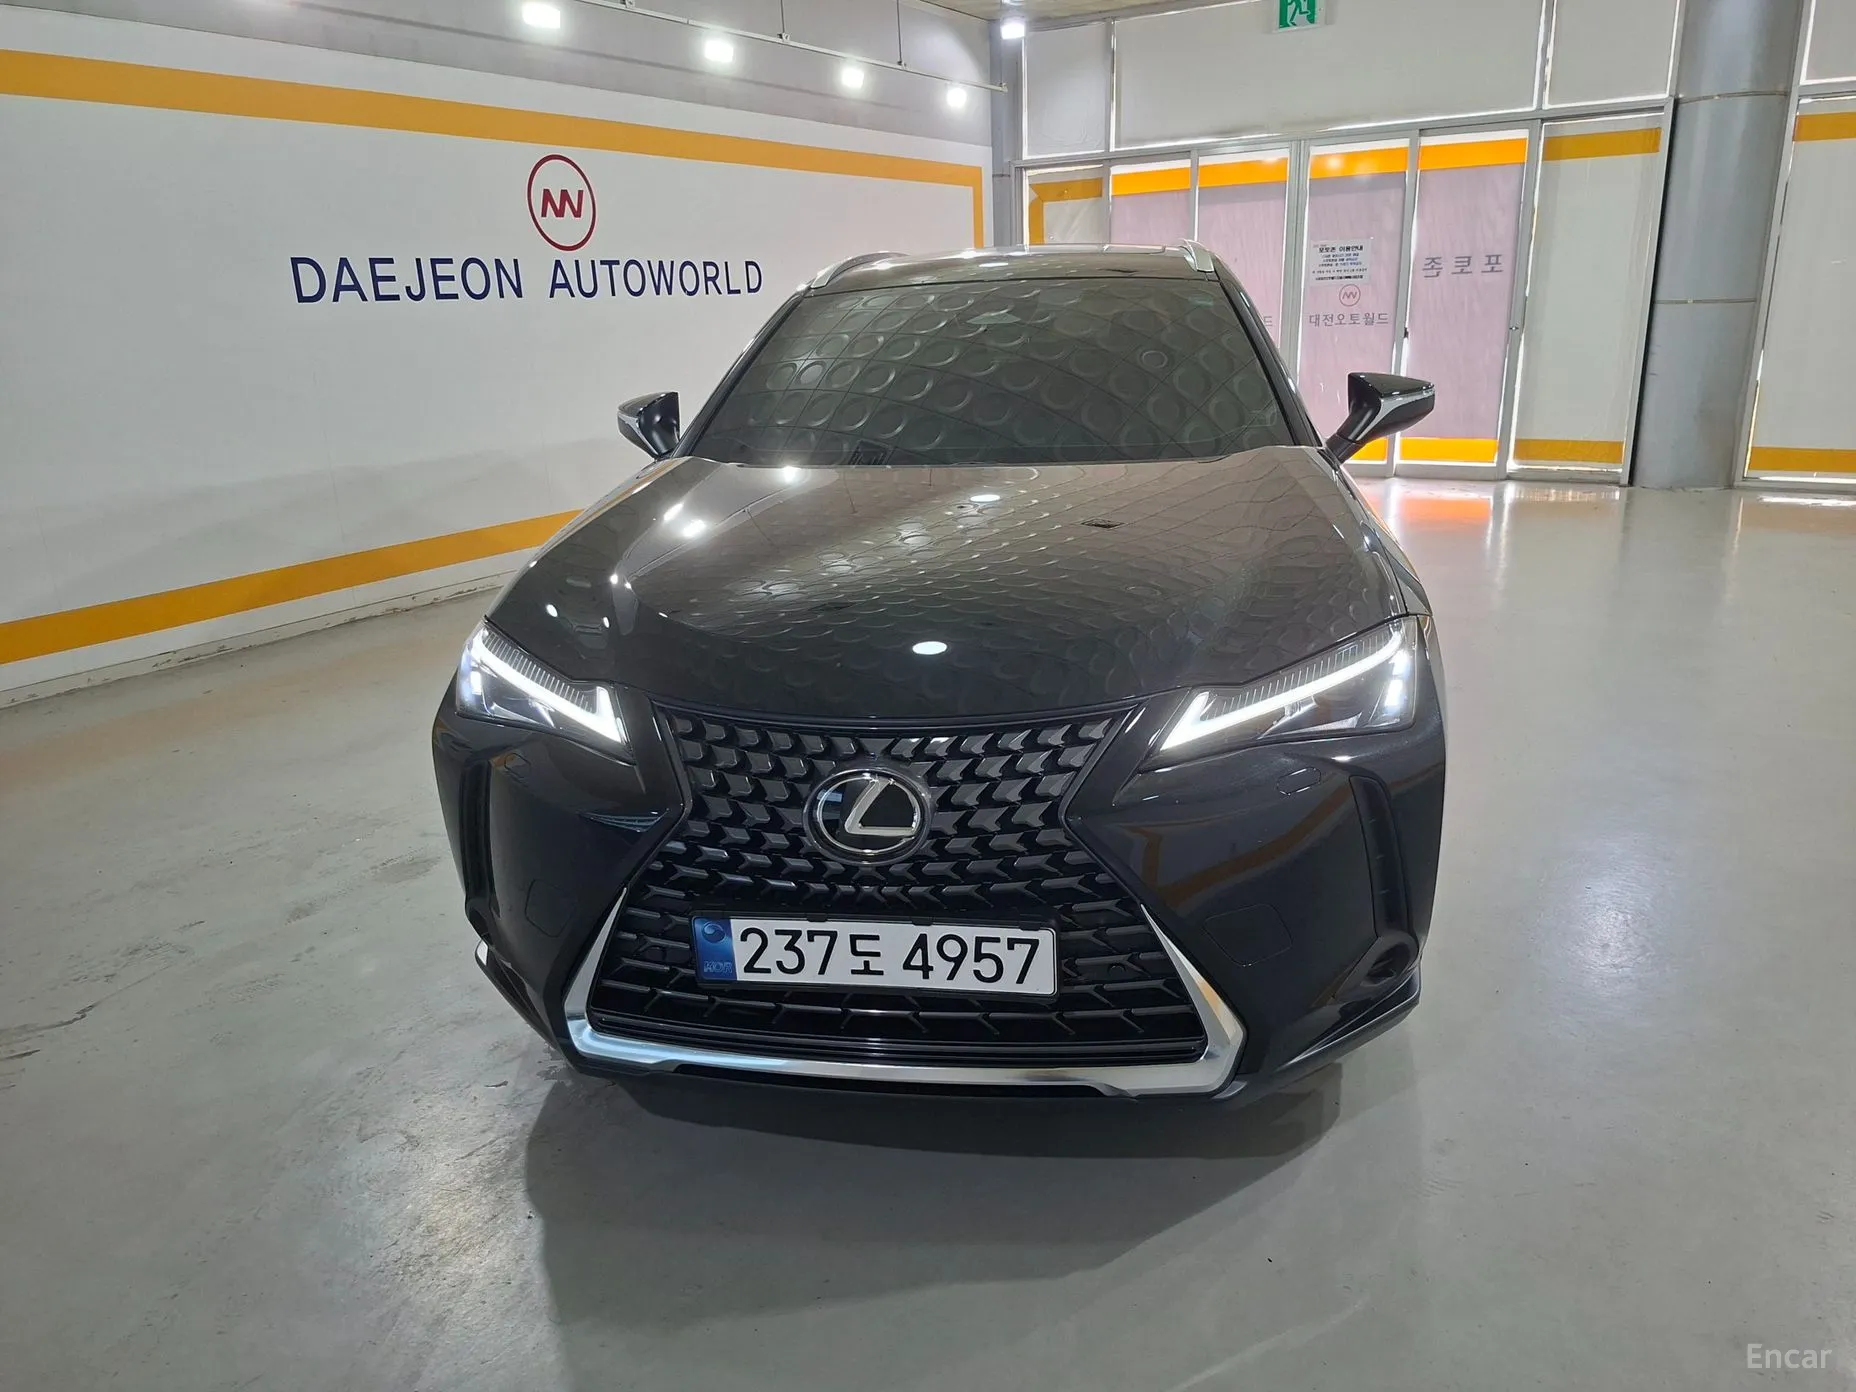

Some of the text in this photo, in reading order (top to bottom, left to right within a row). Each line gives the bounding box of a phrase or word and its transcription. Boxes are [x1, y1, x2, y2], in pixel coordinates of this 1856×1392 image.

[290, 256, 763, 303] DAEJEON AUTOWORLD
[1309, 313, 1389, 327] 대전오토월드
[902, 933, 1039, 985] 4957
